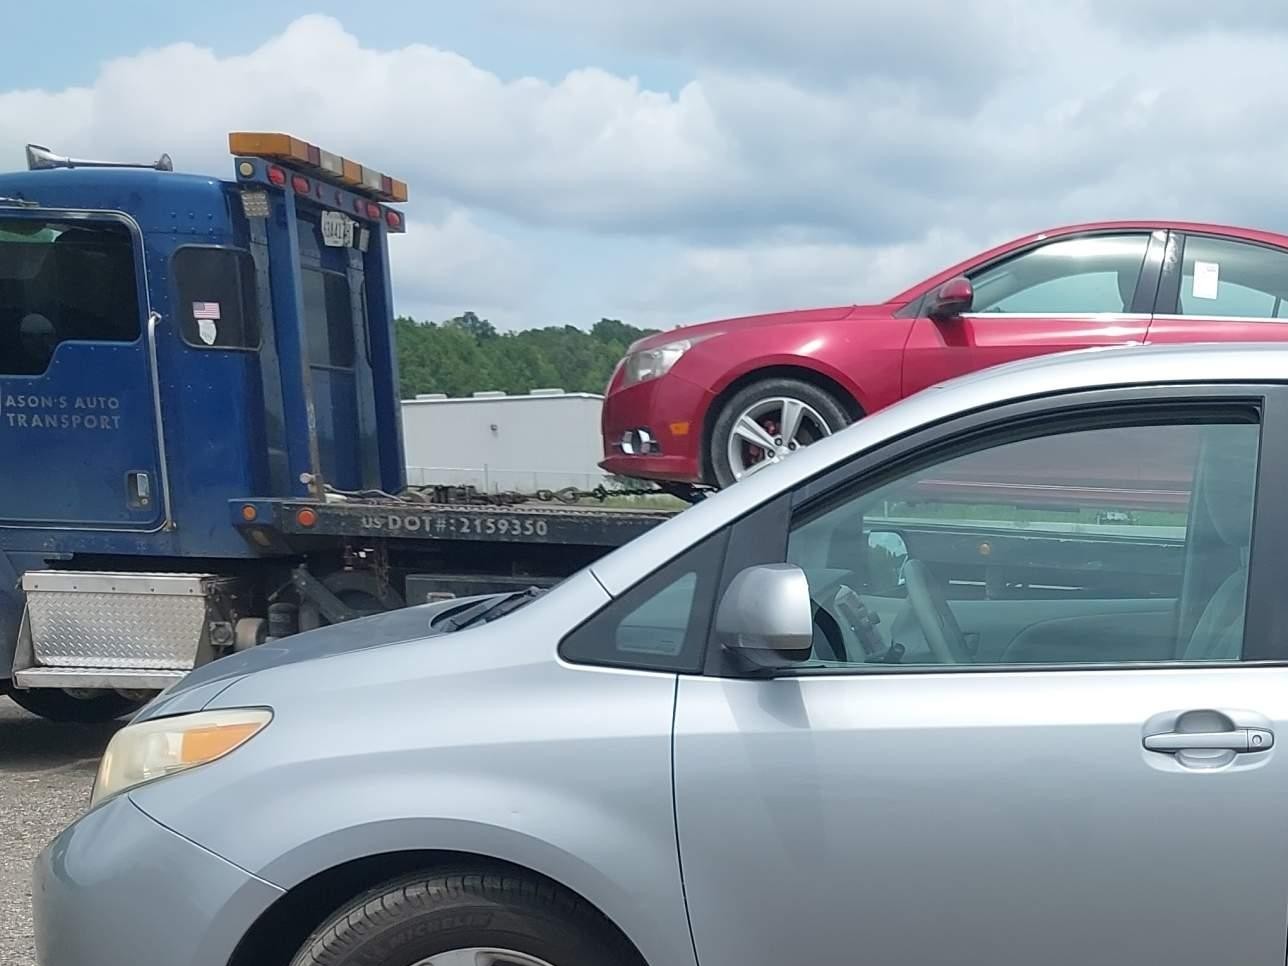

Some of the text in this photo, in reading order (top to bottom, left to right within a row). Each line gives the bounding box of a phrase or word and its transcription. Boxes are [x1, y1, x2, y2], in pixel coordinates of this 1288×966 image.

[0, 393, 120, 409] ASON'S AUTO
[6, 413, 120, 429] TRANSPORT
